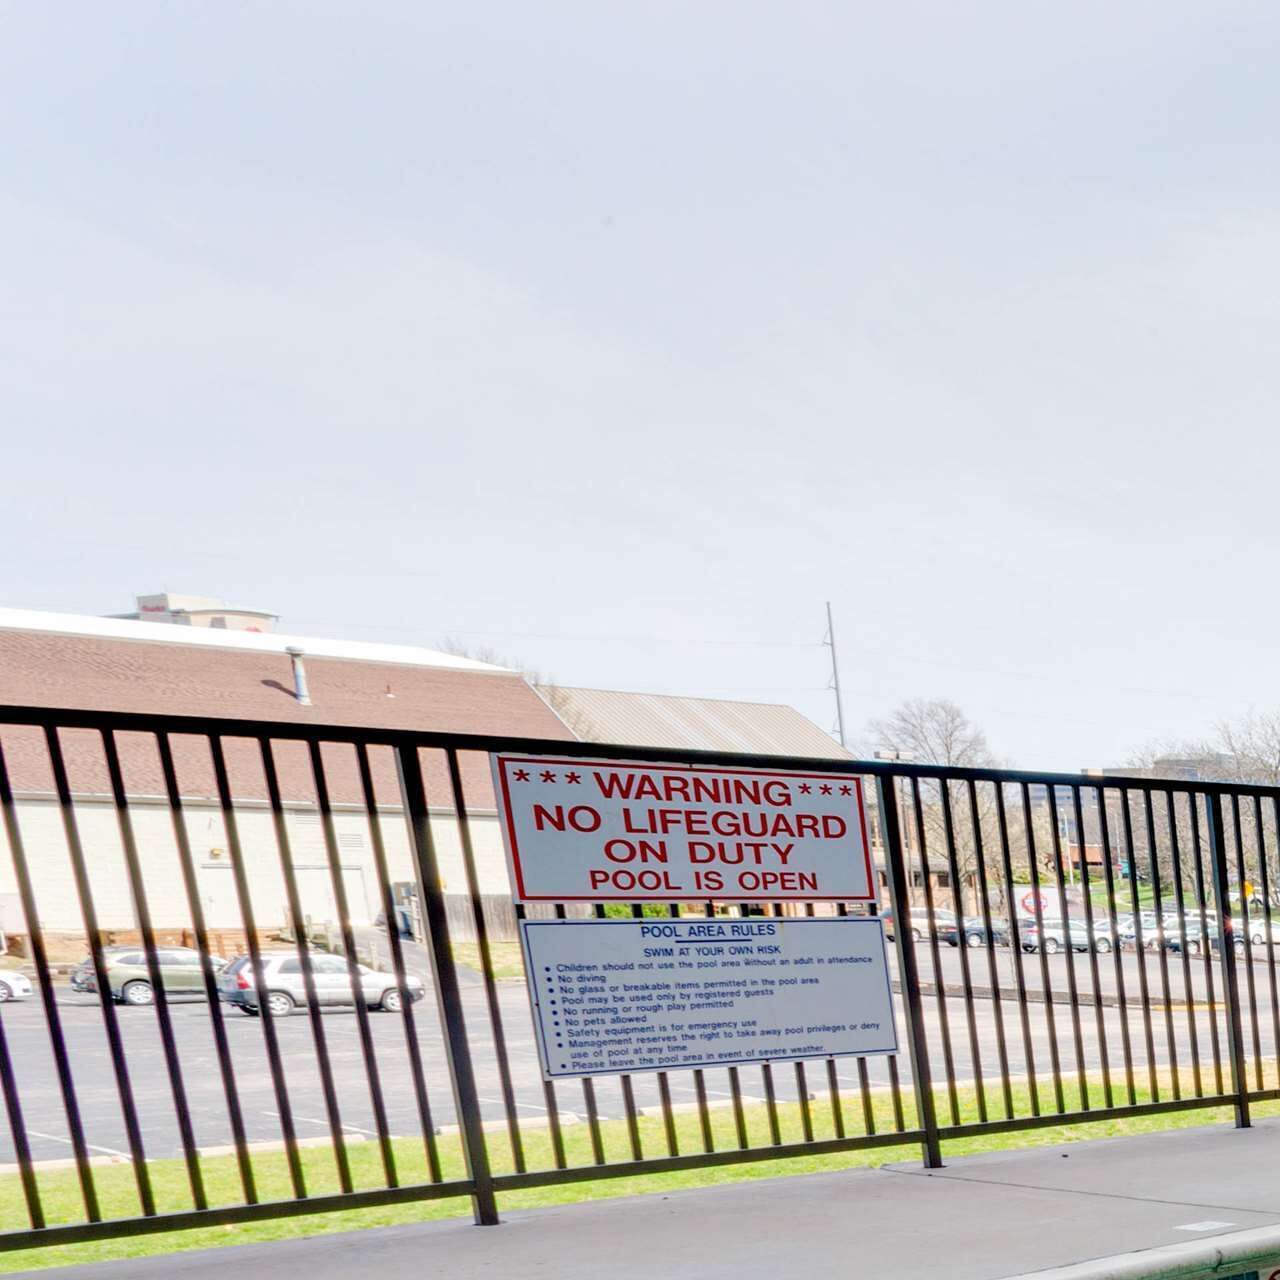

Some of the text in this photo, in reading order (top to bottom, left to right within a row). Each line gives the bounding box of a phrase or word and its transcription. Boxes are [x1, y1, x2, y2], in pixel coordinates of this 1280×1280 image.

[593, 772, 792, 806] WARNING
[534, 804, 846, 838] NO LIFEGUARD
[604, 839, 794, 864] ON DUTY
[590, 870, 818, 890] POOL IS OPEN
[641, 924, 776, 938] POOL AREA RULES
[644, 944, 782, 957] SWIM AT YOUR OWN RISK
[556, 964, 598, 972] Children
[602, 962, 634, 970] should
[638, 962, 654, 970] not
[698, 960, 717, 969] pool
[744, 958, 776, 966] without
[794, 957, 814, 965] adult
[828, 956, 872, 964] attendance
[558, 974, 606, 983] No diving
[560, 986, 574, 994] No
[579, 985, 605, 994] glass
[623, 982, 671, 991] breakable
[704, 980, 747, 988] permitted
[778, 978, 798, 986] pool
[562, 996, 584, 1005] Pool
[588, 996, 608, 1004] may
[630, 994, 653, 1002] used
[656, 993, 675, 1002] only
[680, 992, 690, 1001] by
[695, 990, 740, 1000] registered
[744, 989, 774, 997] guests
[582, 1006, 618, 1015] running
[636, 1004, 663, 1012] rough
[667, 1003, 685, 1011] play
[690, 1000, 734, 1010] permitted
[584, 1018, 605, 1026] pets
[610, 1015, 647, 1024] allowed
[568, 1028, 600, 1037] Safety
[605, 1025, 655, 1035] equipment
[671, 1023, 684, 1031] for
[688, 1021, 737, 1030] emergency
[569, 1037, 632, 1048] Management
[636, 1035, 677, 1043] reserves
[700, 1032, 720, 1041] right
[785, 1026, 804, 1035] pool
[807, 1024, 846, 1033] privileges
[861, 1022, 880, 1030] deny
[572, 1060, 605, 1069] Please
[609, 1058, 634, 1066] leave
[639, 1056, 654, 1064] the
[658, 1055, 678, 1064] pool
[746, 1049, 754, 1057] of
[759, 1048, 787, 1056] severe
[608, 1048, 628, 1056] pool
[647, 1047, 663, 1055] any
